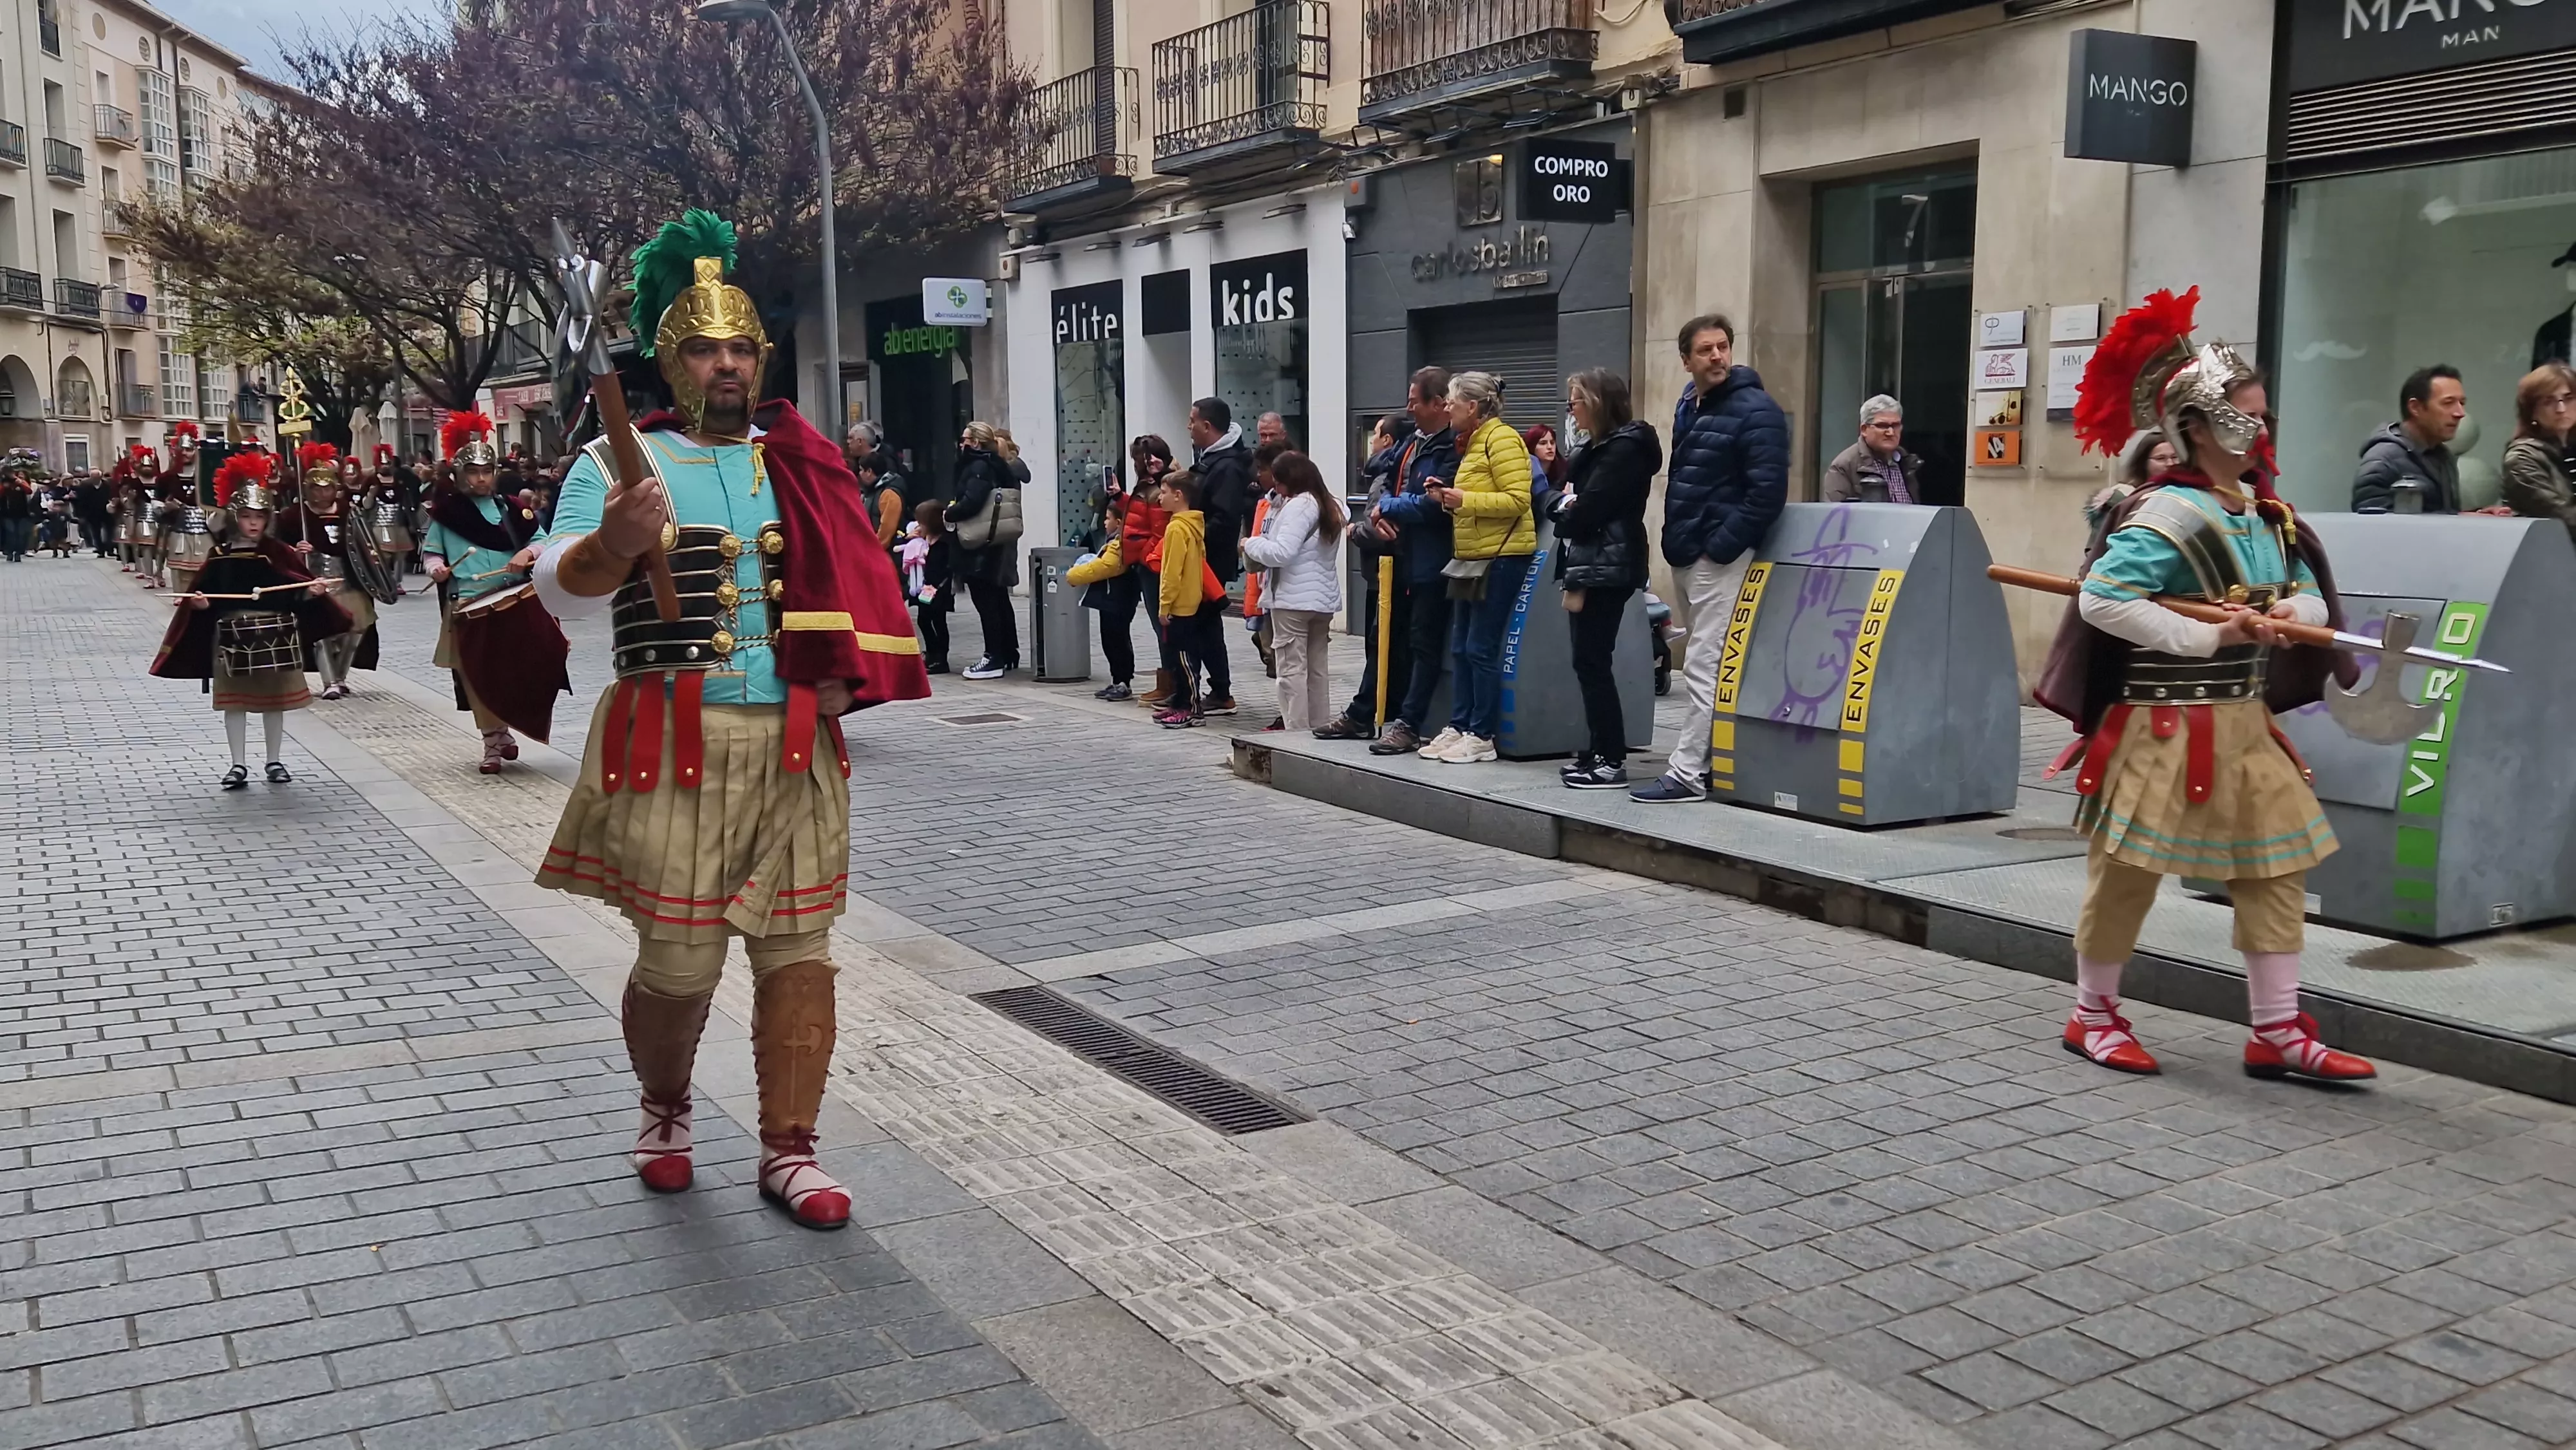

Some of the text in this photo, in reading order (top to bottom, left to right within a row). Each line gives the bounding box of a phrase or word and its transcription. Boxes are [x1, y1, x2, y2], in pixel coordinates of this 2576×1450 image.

[2441, 25, 2500, 48] MAN
[2089, 73, 2188, 106] MANGO
[1535, 156, 1608, 178] COMPRO
[1553, 184, 1591, 203] ORO
[1222, 272, 1294, 326] kids
[1056, 301, 1118, 344] élite
[2062, 354, 2081, 366] HM
[1503, 626, 1520, 673] PAPEL
[1719, 568, 1765, 704] ENVASES
[1846, 577, 1896, 722] ENVASES
[2405, 612, 2476, 797] VIDRO
